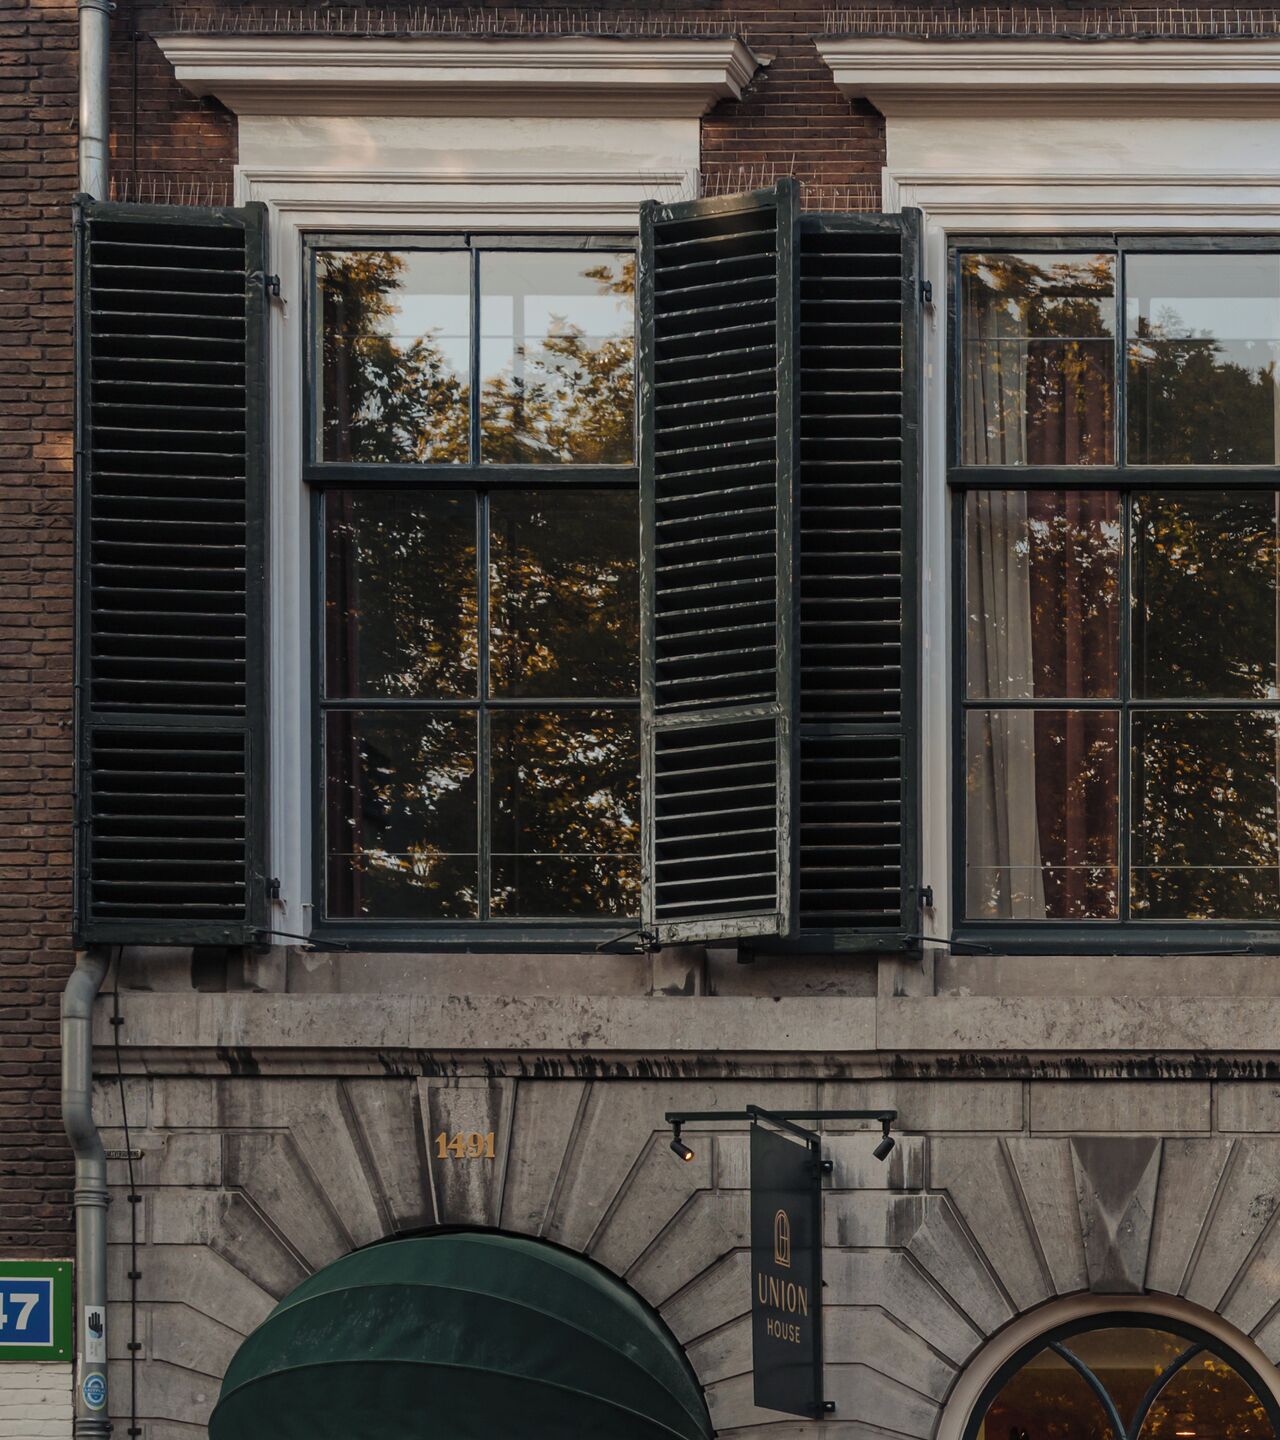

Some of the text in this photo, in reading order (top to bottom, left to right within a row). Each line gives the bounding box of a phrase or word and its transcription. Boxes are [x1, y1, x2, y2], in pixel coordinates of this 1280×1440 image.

[435, 1131, 496, 1159] 1491
[0, 1292, 39, 1330] 7
[758, 1273, 808, 1317] UNION
[767, 1318, 801, 1343] HOUSE
